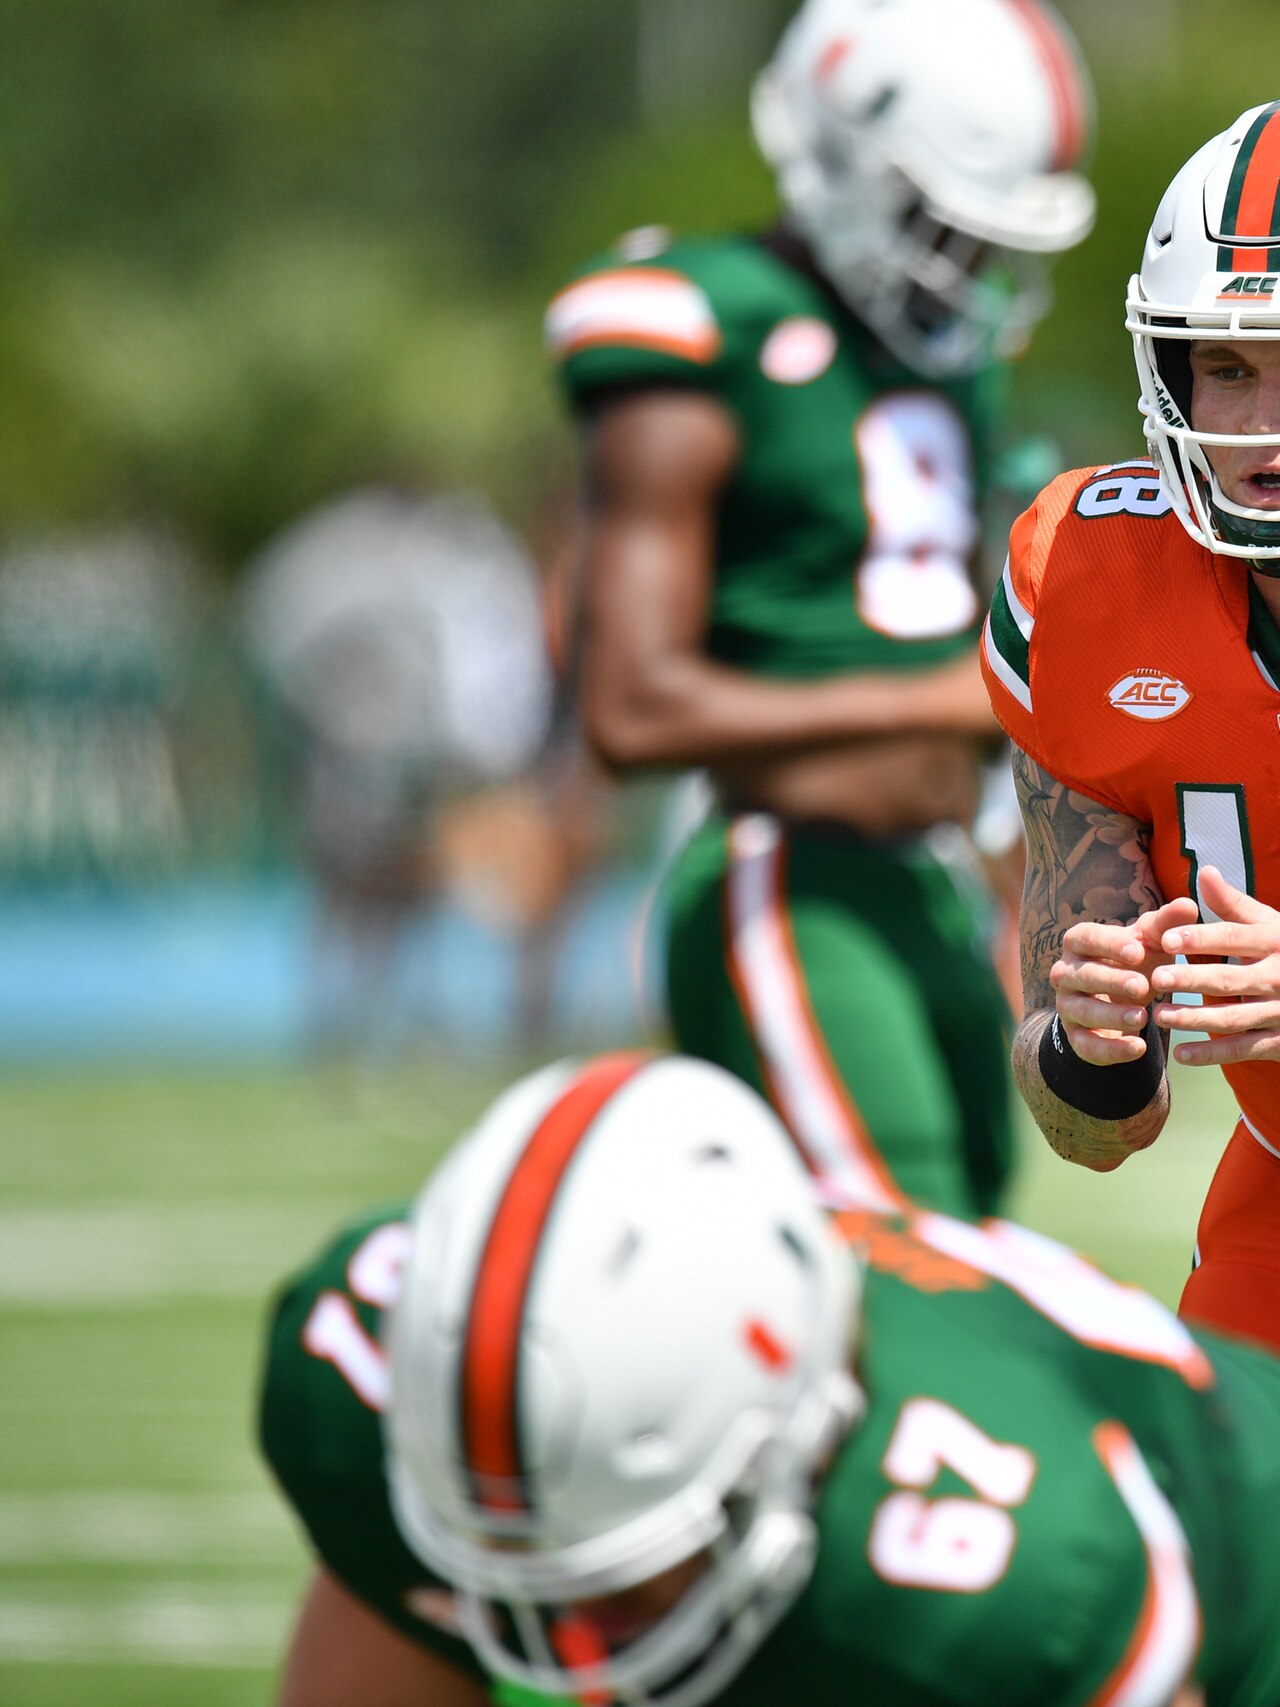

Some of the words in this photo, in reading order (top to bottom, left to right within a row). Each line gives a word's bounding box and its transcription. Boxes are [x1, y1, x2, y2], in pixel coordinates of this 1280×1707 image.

[1221, 276, 1279, 293] ACC
[1119, 682, 1179, 702] ACC
[868, 1395, 1037, 1592] 67
